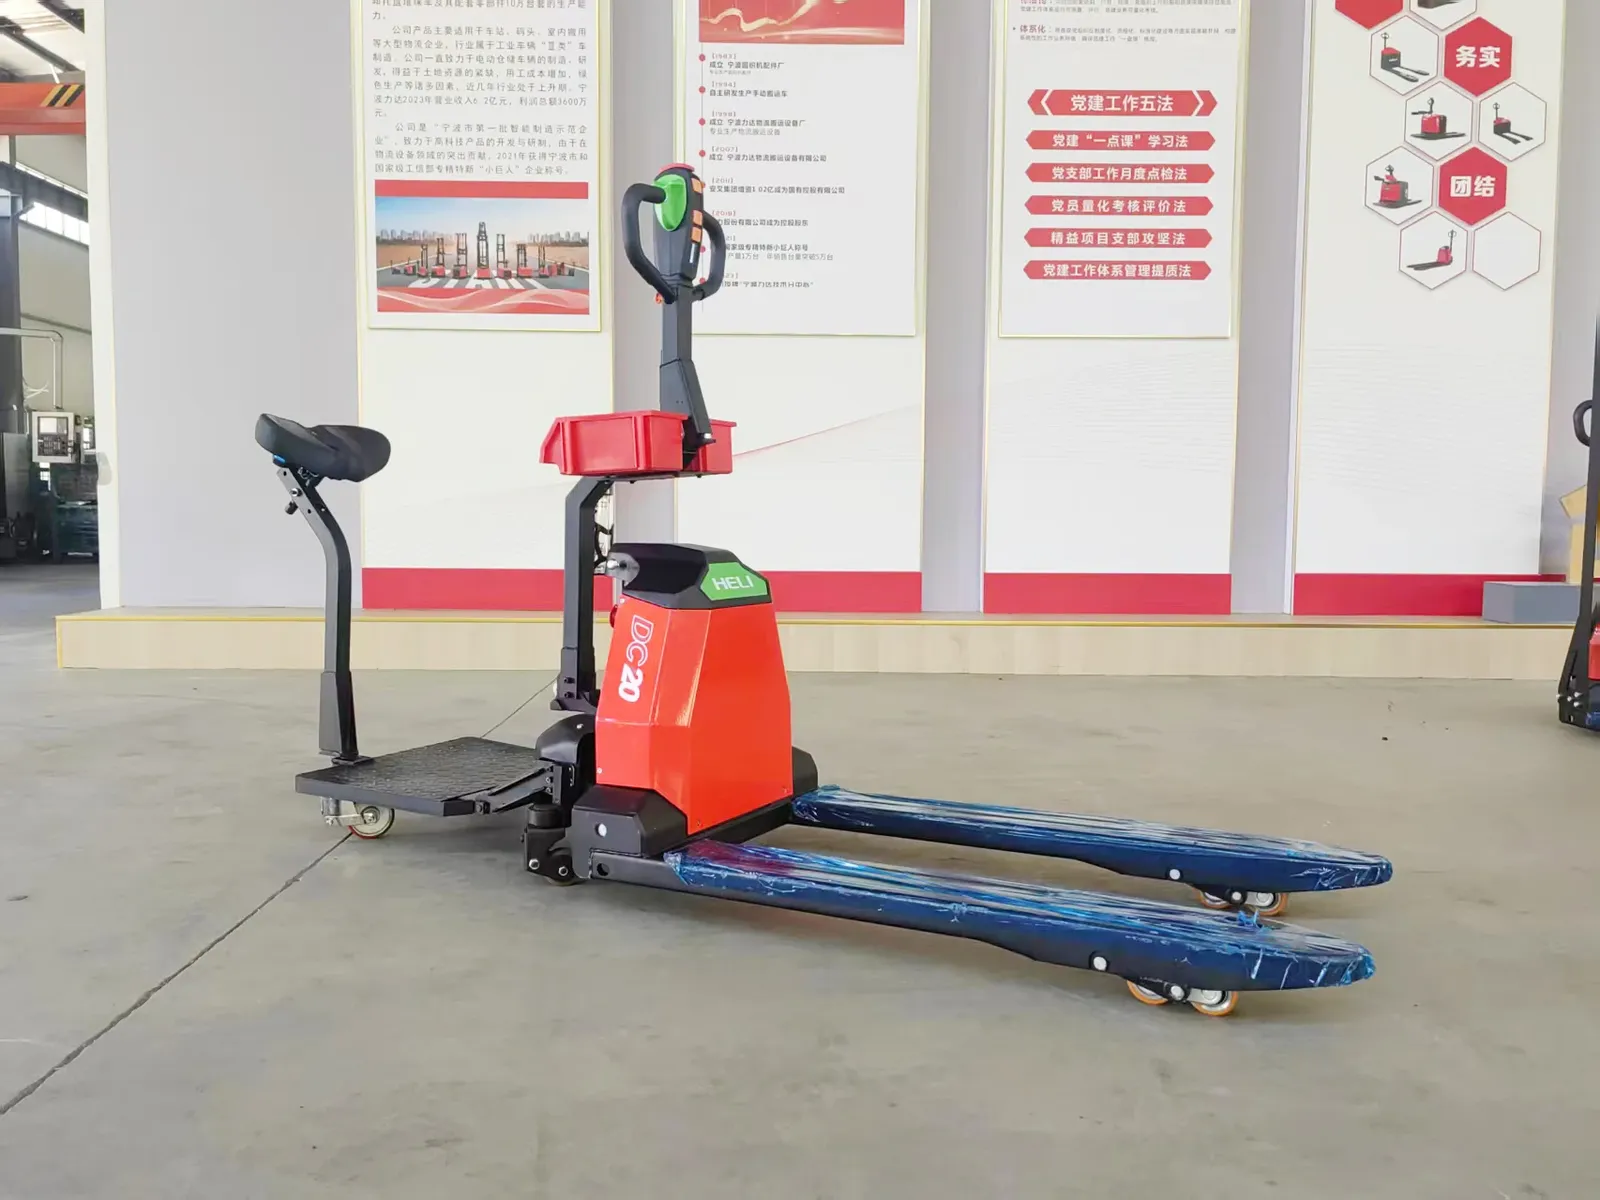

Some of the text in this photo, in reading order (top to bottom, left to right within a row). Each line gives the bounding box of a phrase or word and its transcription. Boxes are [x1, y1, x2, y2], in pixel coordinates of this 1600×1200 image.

[1456, 45, 1501, 68] 务实
[1070, 94, 1174, 112] 党建工作五法
[1051, 166, 1188, 181] 党支部工作月度点检法
[1450, 175, 1496, 198] 团结
[1051, 199, 1186, 213] 党员量化考核评价法
[1050, 231, 1186, 245] 精益项目支部攻坚法
[1043, 263, 1192, 278] 党建工作体系管理提质法
[711, 575, 754, 591] HELI
